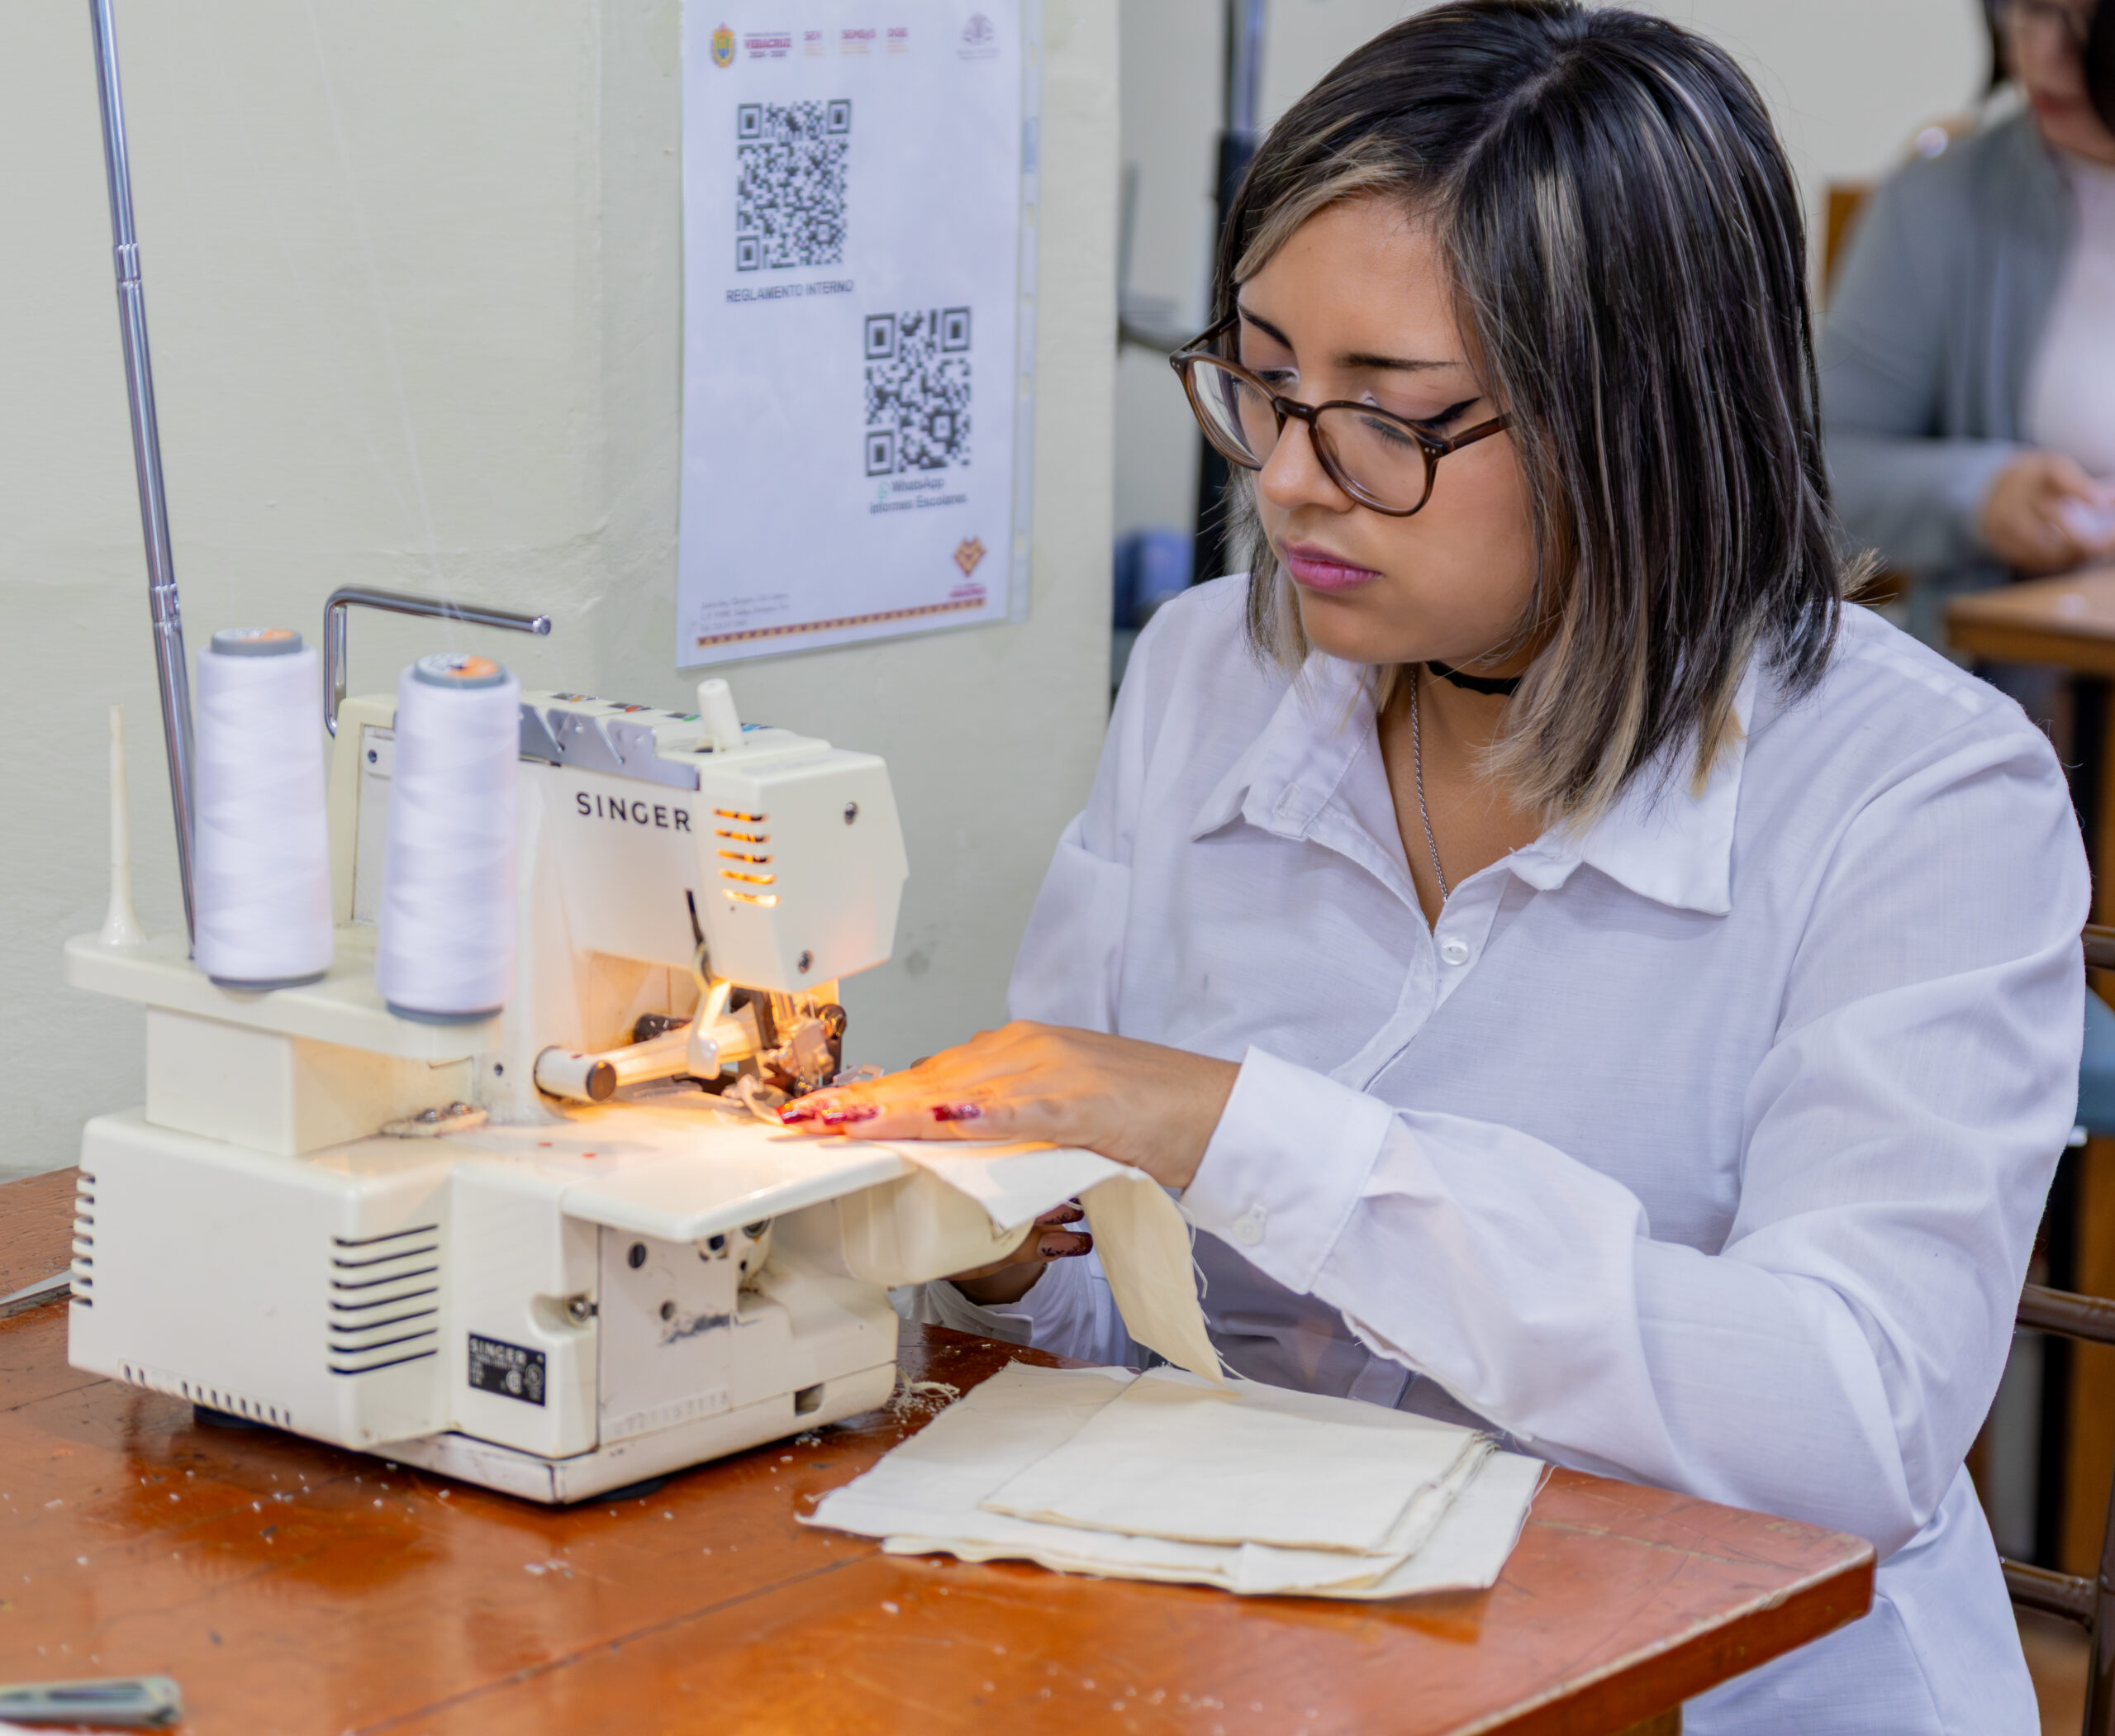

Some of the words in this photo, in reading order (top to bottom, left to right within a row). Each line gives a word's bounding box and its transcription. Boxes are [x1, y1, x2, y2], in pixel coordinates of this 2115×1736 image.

[726, 283, 803, 302] REGLAMENTO
[806, 279, 854, 296] INTERNO
[892, 477, 945, 492] WhatsApp
[916, 493, 967, 508] Escolares
[576, 792, 691, 831] SINGER
[469, 1338, 526, 1363] SINGER
